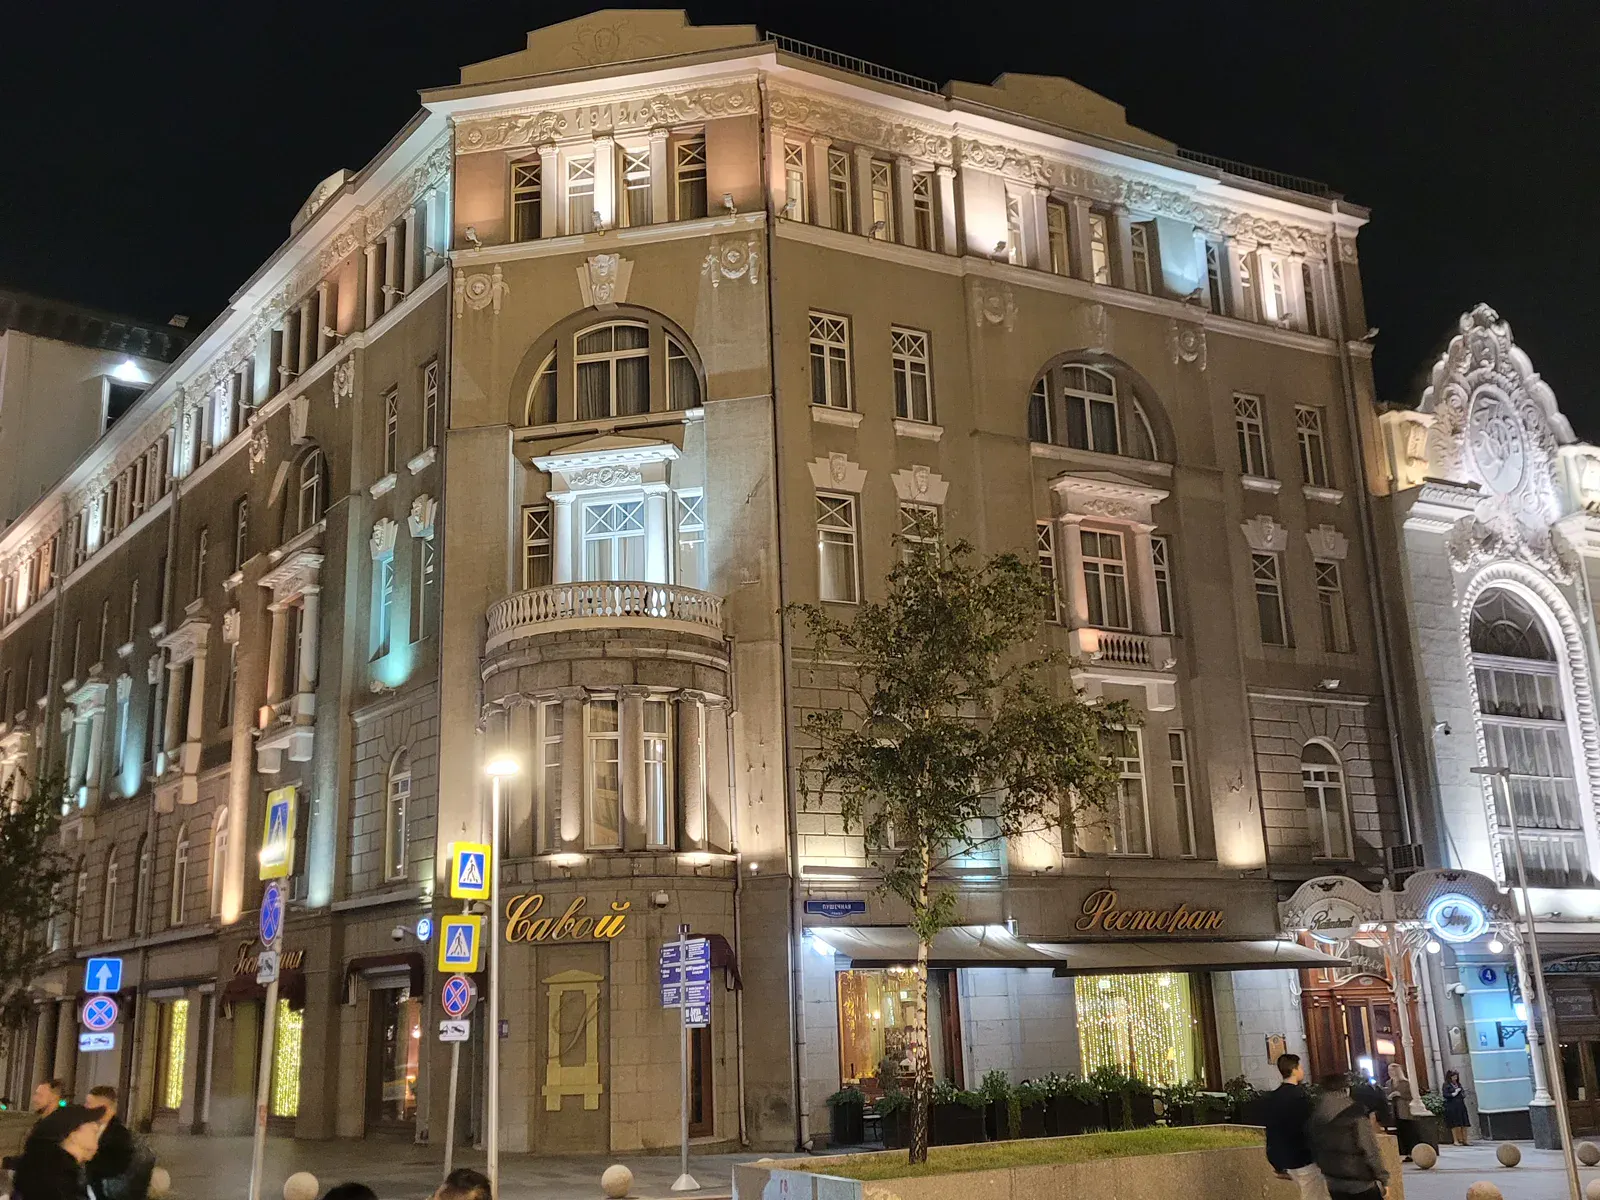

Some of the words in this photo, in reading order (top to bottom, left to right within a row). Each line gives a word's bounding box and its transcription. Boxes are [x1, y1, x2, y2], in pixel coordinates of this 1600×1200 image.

[505, 893, 631, 943] Савой
[1075, 889, 1225, 933] Ресторан
[1486, 969, 1492, 981] 4
